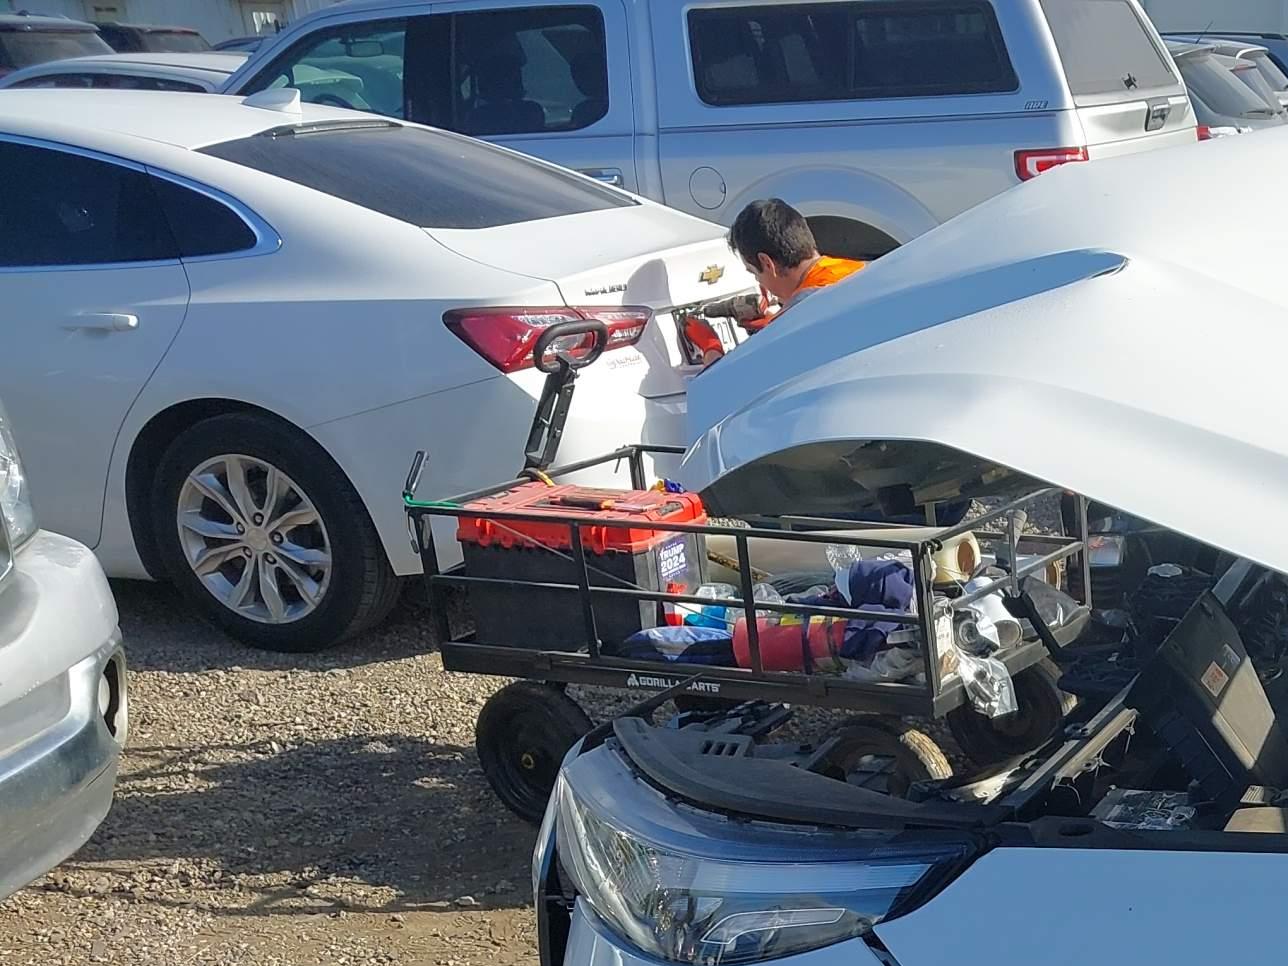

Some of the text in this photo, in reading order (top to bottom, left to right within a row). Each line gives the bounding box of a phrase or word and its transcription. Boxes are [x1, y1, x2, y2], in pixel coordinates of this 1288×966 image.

[660, 543, 684, 561] TRUMP
[660, 552, 686, 573] 2024
[686, 681, 721, 693] ARTS
